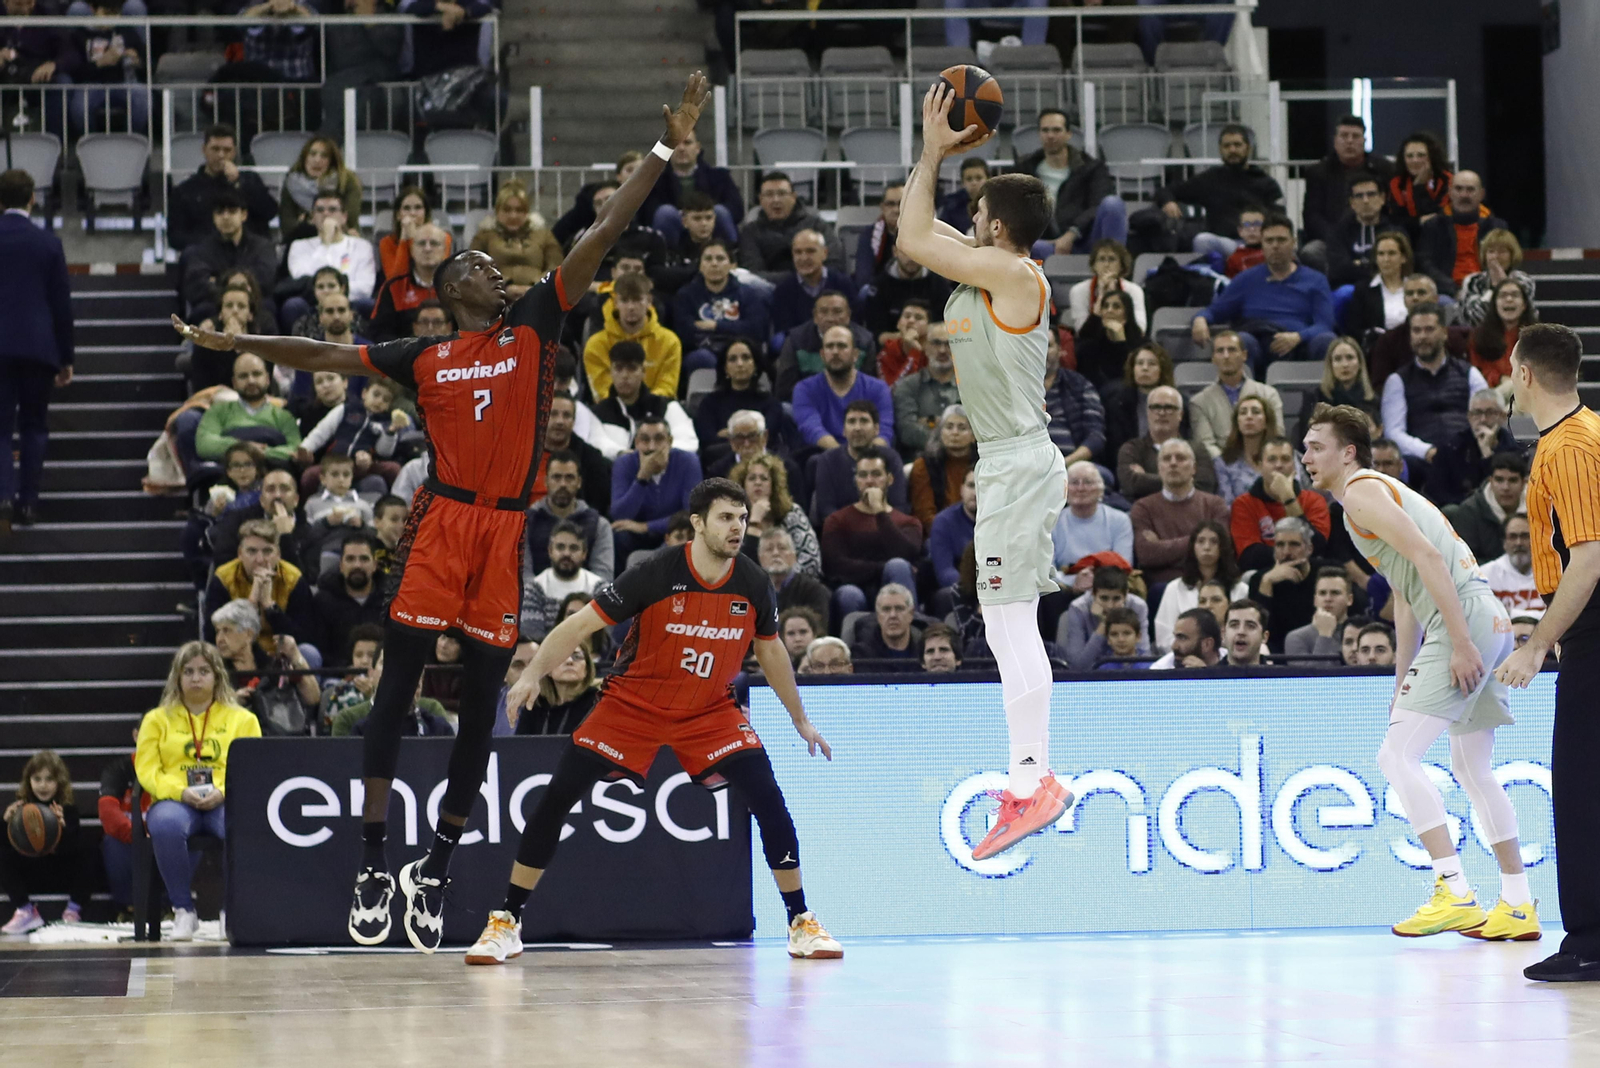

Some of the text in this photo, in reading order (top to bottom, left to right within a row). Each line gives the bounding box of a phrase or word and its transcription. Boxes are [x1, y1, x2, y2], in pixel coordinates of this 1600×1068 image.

[473, 389, 493, 422] 7
[416, 615, 440, 625] asisa
[680, 647, 716, 680] 20
[597, 741, 620, 759] asisa
[714, 739, 744, 758] BERNER
